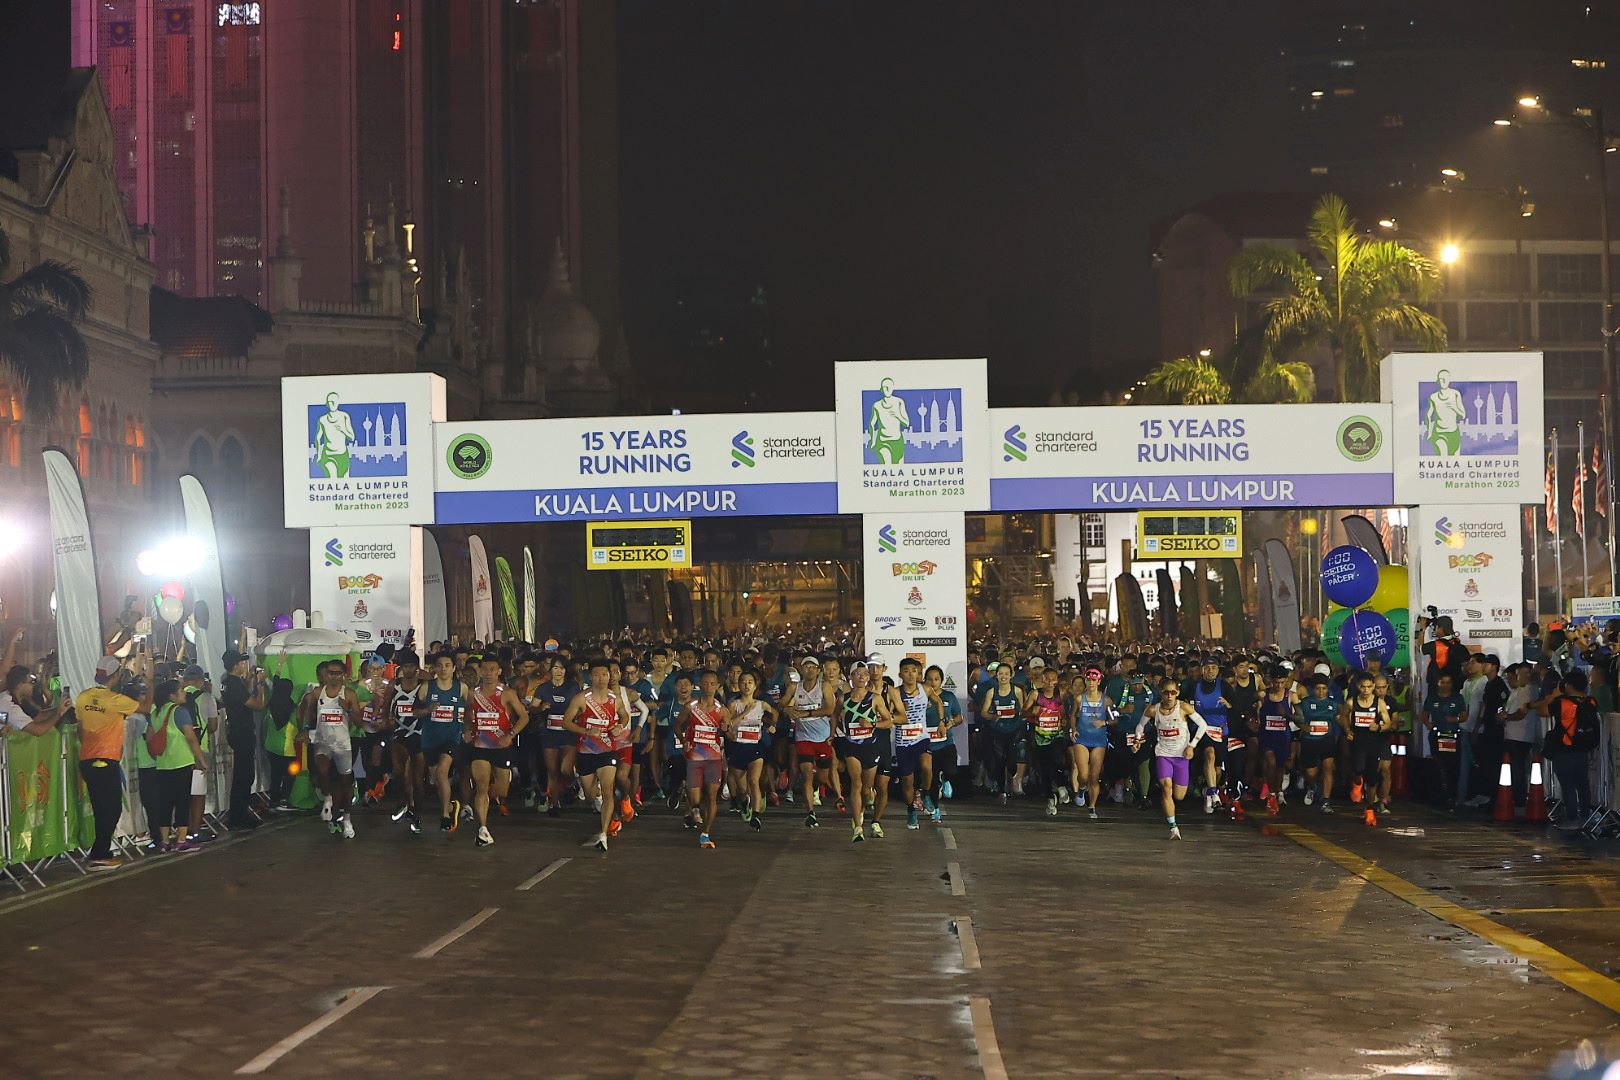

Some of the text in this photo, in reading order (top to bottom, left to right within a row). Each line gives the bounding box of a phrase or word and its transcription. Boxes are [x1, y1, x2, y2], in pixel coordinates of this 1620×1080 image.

[1140, 418, 1245, 438] 15 YEARS
[582, 430, 686, 450] 15 YEARS
[1035, 430, 1094, 442] standard
[763, 436, 821, 448] standard
[1036, 442, 1098, 452] chartered
[763, 447, 825, 458] chartered
[1138, 442, 1248, 462] RUNNING
[580, 454, 691, 474] RUNNING
[1419, 460, 1520, 469] KUALA LUMPUR
[863, 468, 964, 478] KUALA LUMPUR
[1419, 470, 1520, 479] Standard Chartered
[309, 482, 408, 491] KUALA LUMPUR
[863, 478, 964, 488] Standard Chartered
[309, 492, 409, 502] Standard Chartered
[889, 488, 965, 497] Marathon 2023
[1092, 480, 1295, 504] KUALA LUMPUR
[335, 502, 409, 510] Marathon 2023
[534, 490, 737, 516] KUALA LUMPUR
[1458, 522, 1504, 530] standard
[902, 530, 948, 538] standard
[348, 543, 392, 552] standard
[902, 538, 951, 546] chartered
[1161, 538, 1220, 550] SEIKO
[348, 551, 396, 560] chartered
[608, 549, 668, 561] SEIKO
[1448, 552, 1493, 568] BOOST
[892, 560, 938, 577] BOOST
[1324, 564, 1356, 578] SEIKO
[338, 573, 383, 590] BOOST
[1328, 573, 1354, 586] PACER
[380, 629, 402, 638] 100
[1353, 638, 1388, 652] SEIKO
